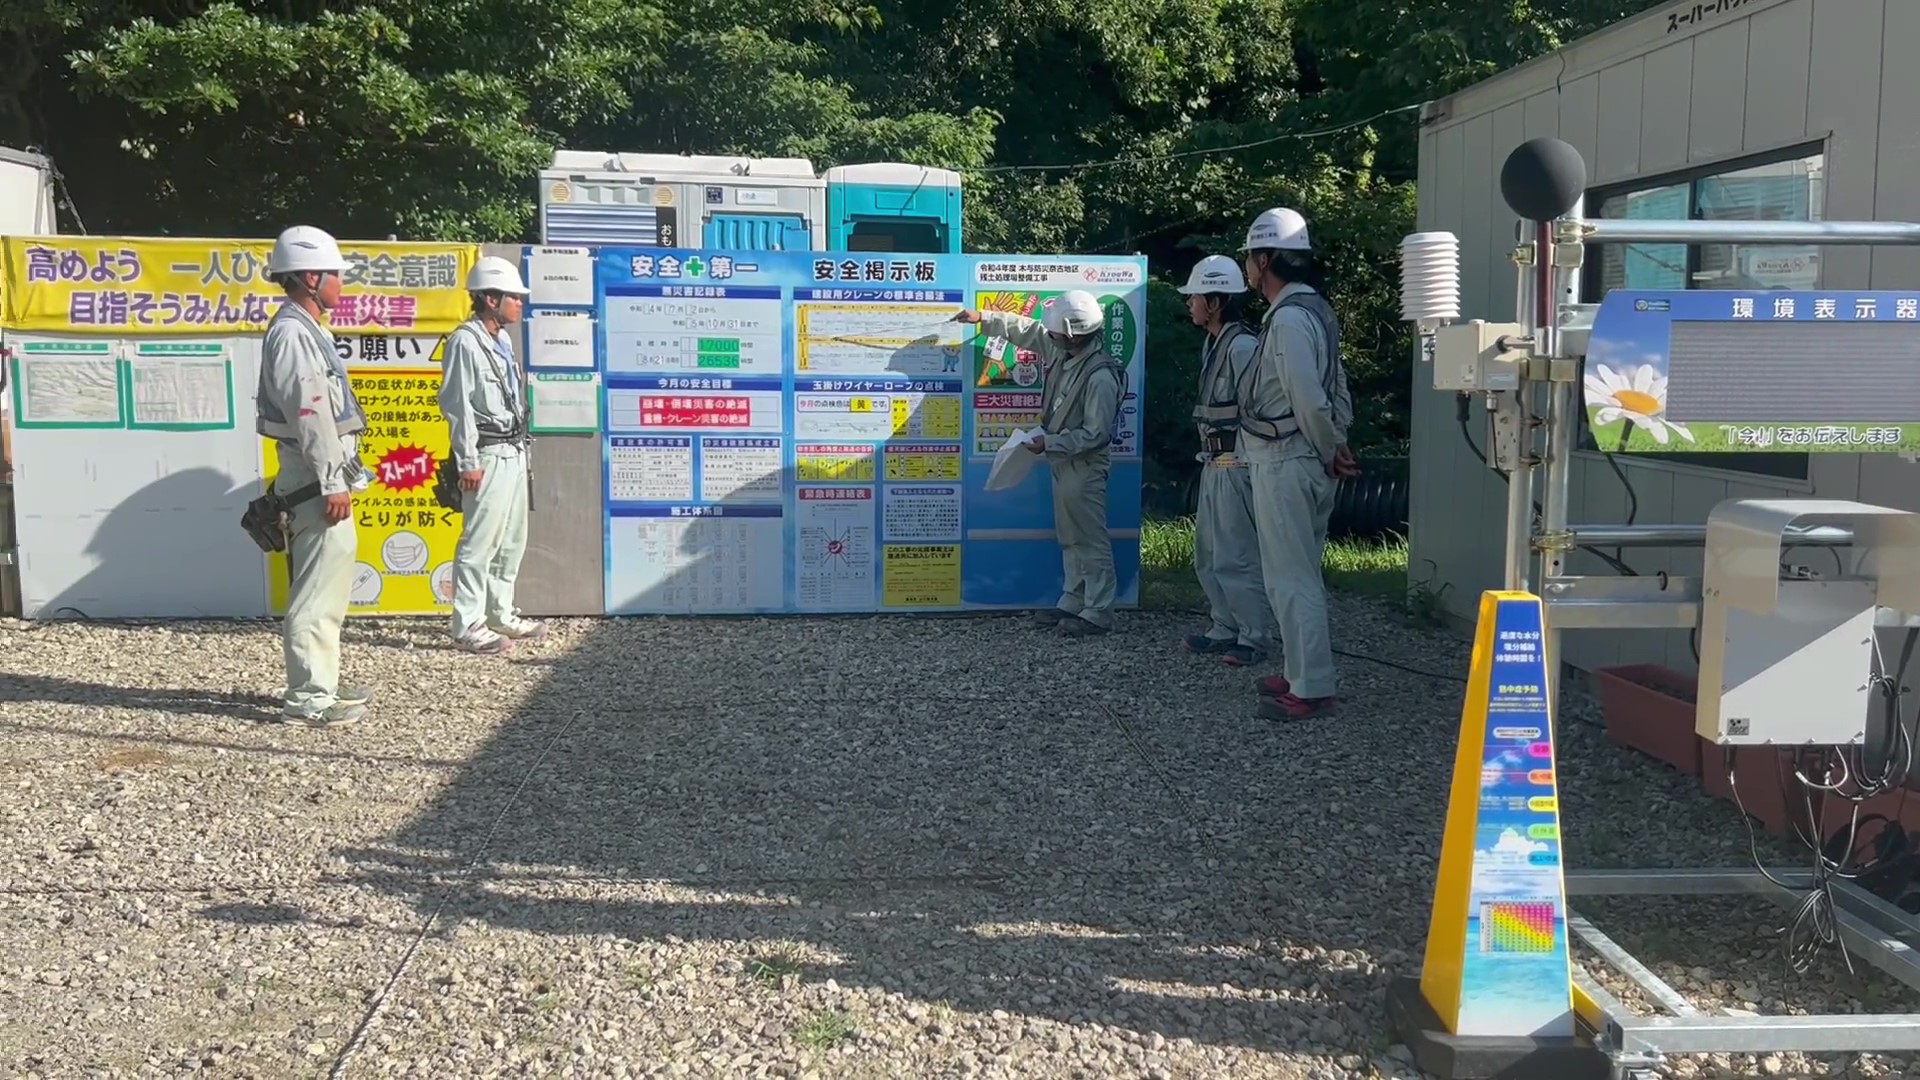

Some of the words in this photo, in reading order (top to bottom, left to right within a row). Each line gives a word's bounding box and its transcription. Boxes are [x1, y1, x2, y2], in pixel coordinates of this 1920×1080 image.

[26, 247, 140, 282] 高めよう
[172, 250, 457, 289] 一人ひ安全意識
[630, 256, 681, 278] 安全
[709, 257, 759, 279] 第一
[815, 260, 936, 282] 安全掲示板
[329, 293, 416, 327] 無災害
[1731, 298, 1919, 319] 環境表示器
[699, 339, 740, 352] 17000
[658, 379, 733, 389] 今月の安全目標
[812, 381, 944, 392] 玉掛けワイヤーロープの点検
[359, 426, 411, 438] の入場を
[381, 453, 429, 483] ストップ
[671, 506, 723, 517] 施工体系図
